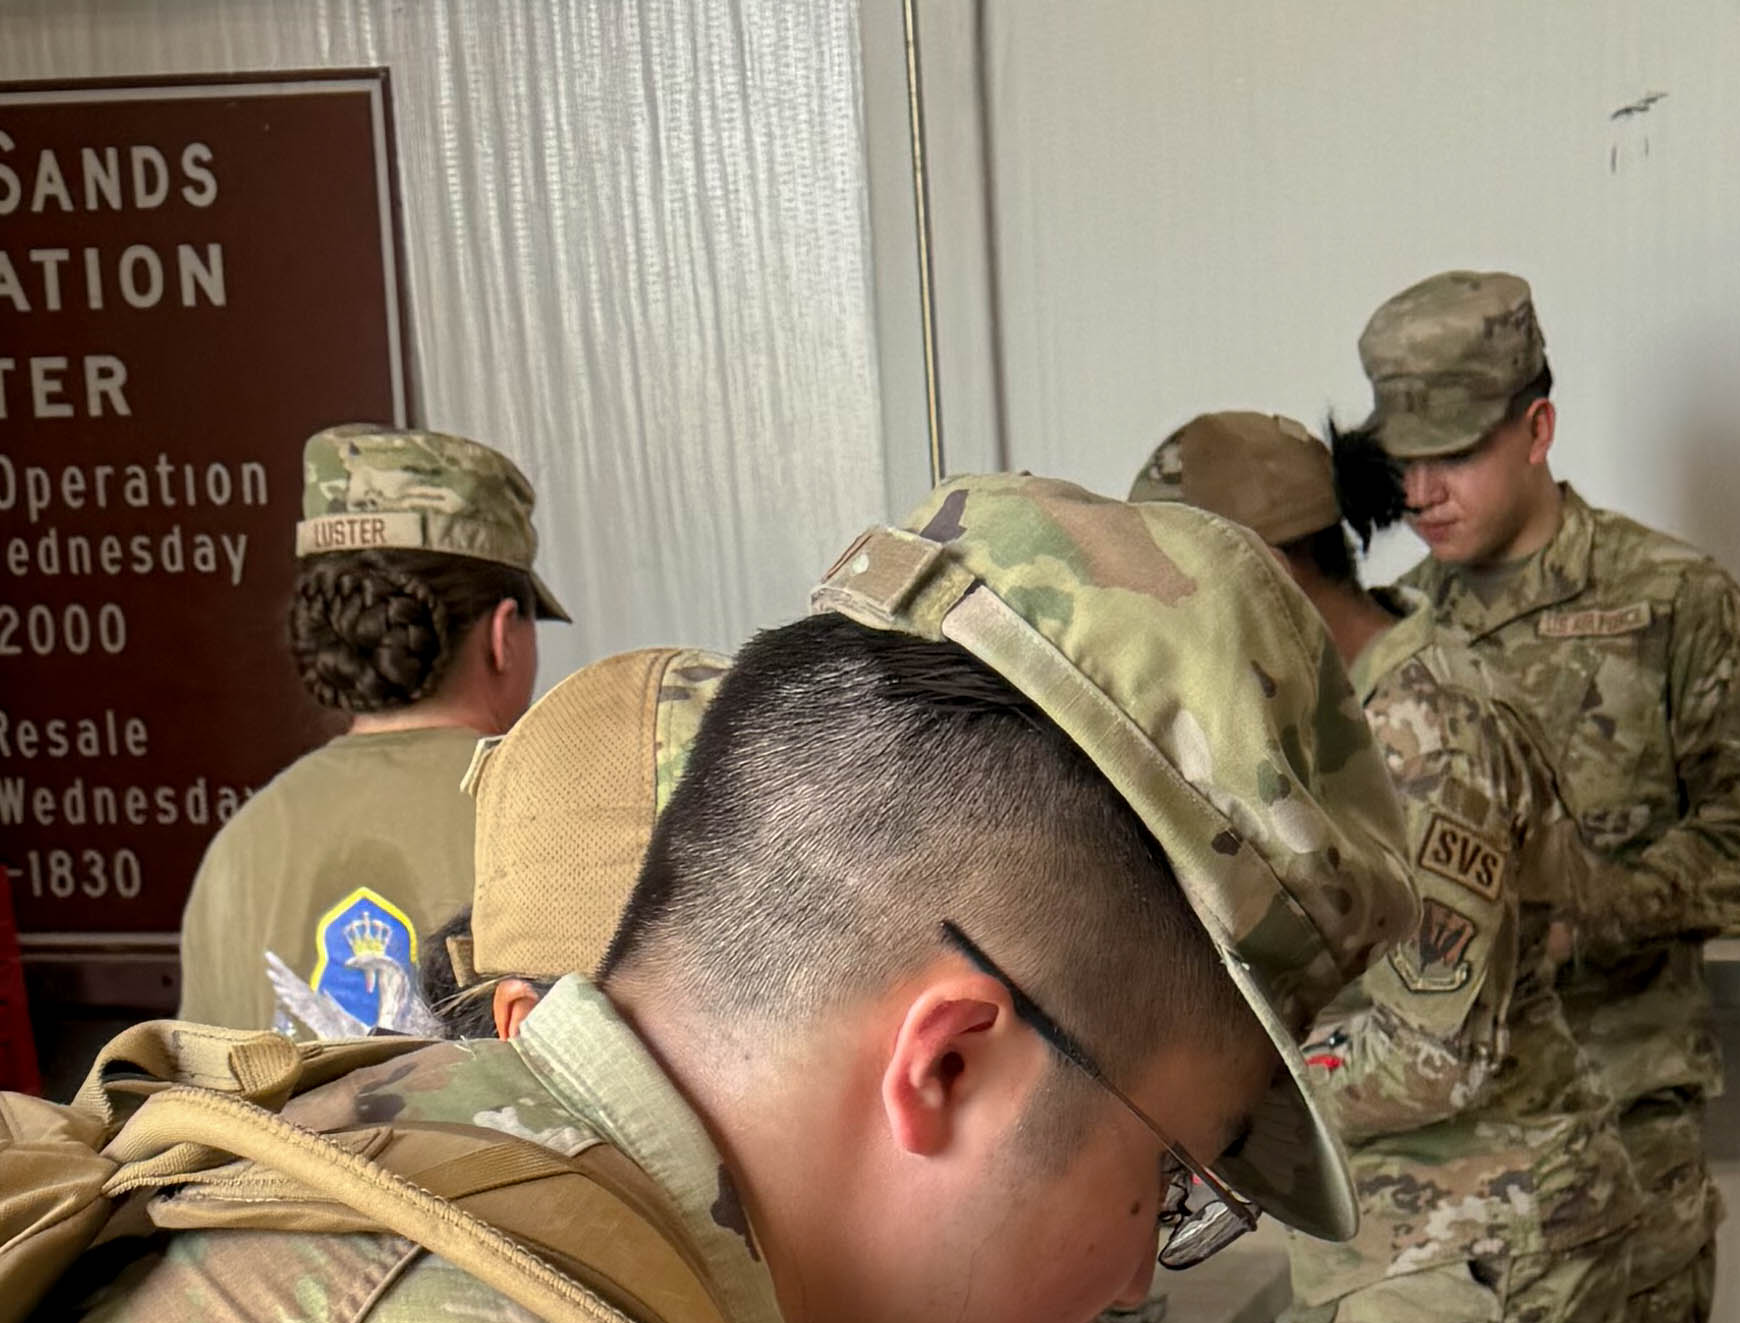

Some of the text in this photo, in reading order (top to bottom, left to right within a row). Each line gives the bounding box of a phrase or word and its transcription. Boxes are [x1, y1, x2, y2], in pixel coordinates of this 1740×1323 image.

[314, 518, 386, 548] LUSTER
[0, 603, 127, 655] 2000
[0, 777, 253, 826] Wednesda
[1433, 830, 1499, 888] SVS
